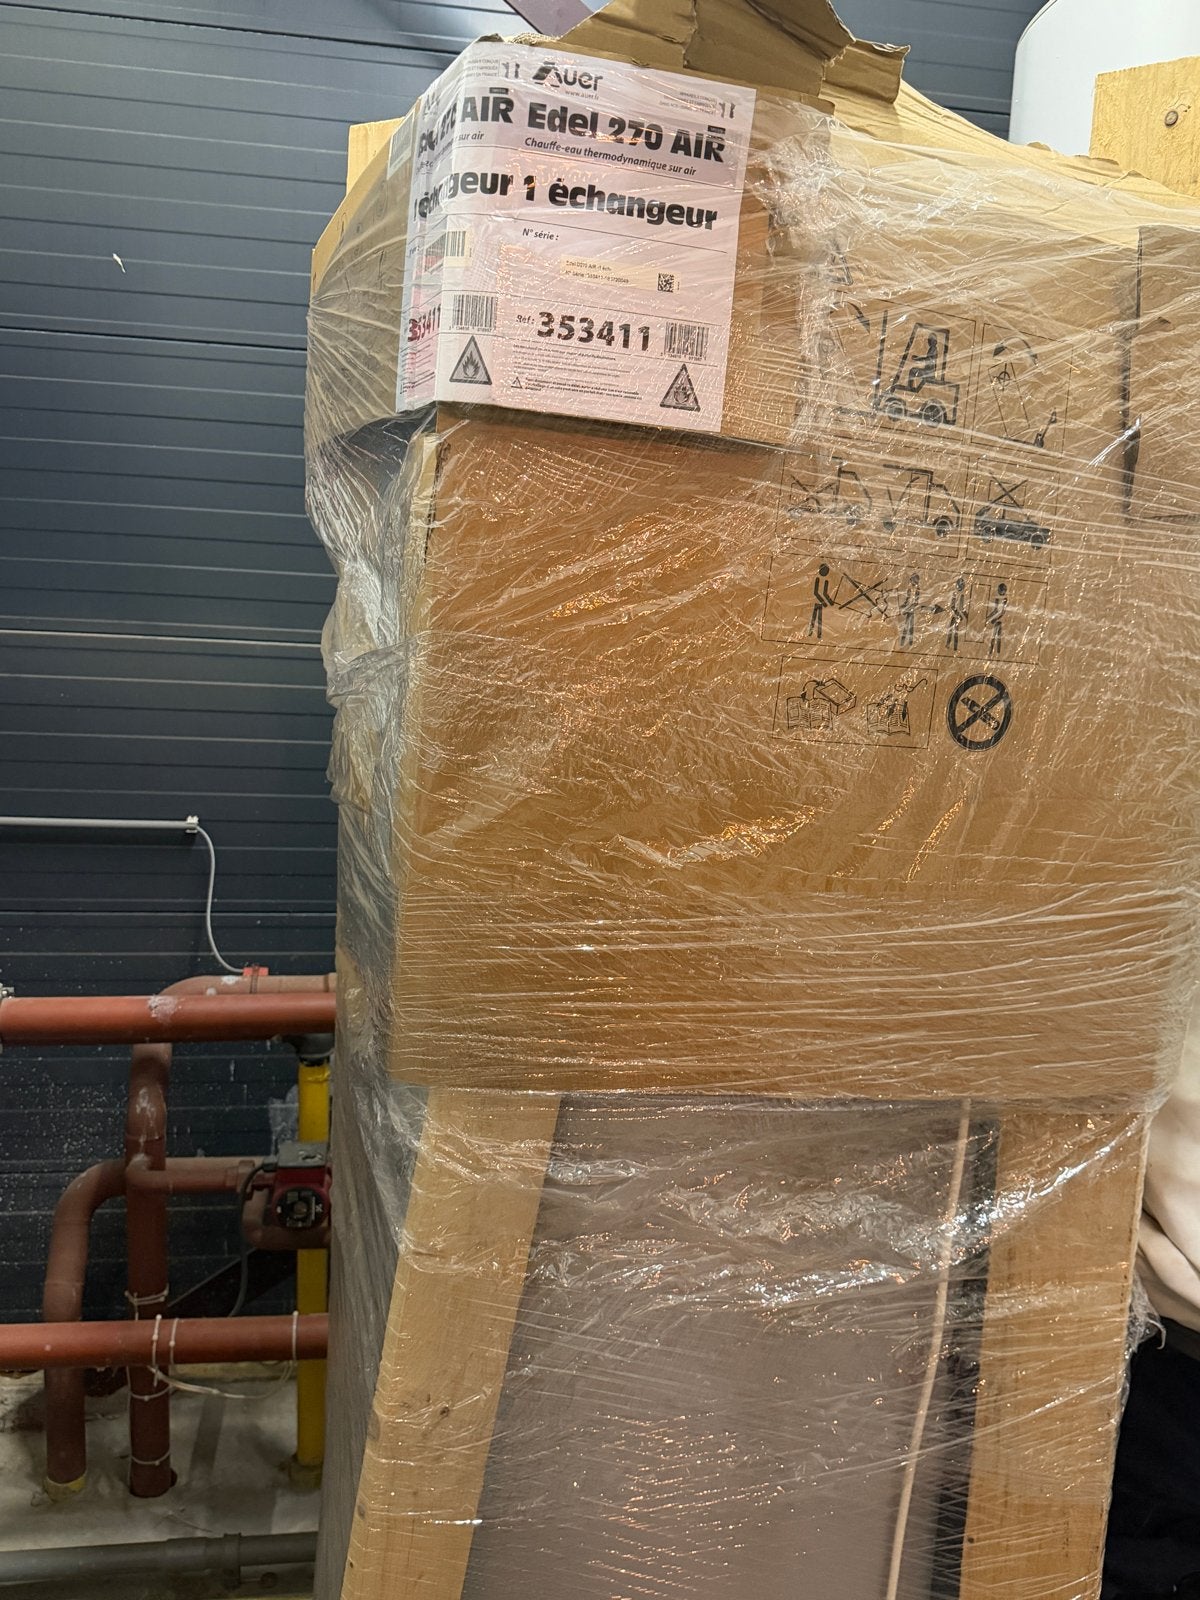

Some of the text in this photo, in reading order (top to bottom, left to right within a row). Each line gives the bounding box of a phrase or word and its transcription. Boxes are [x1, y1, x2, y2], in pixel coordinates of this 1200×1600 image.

[532, 61, 603, 91] Auer
[460, 96, 514, 123] AIR
[471, 130, 485, 141] air
[528, 102, 725, 163] Edel 270 AIR
[524, 136, 697, 176] Chauffe-eau thermodynamique sur air
[523, 174, 718, 230] 1 échangeur
[522, 227, 533, 236] N°
[534, 229, 555, 240] série
[537, 311, 651, 351] 353411
